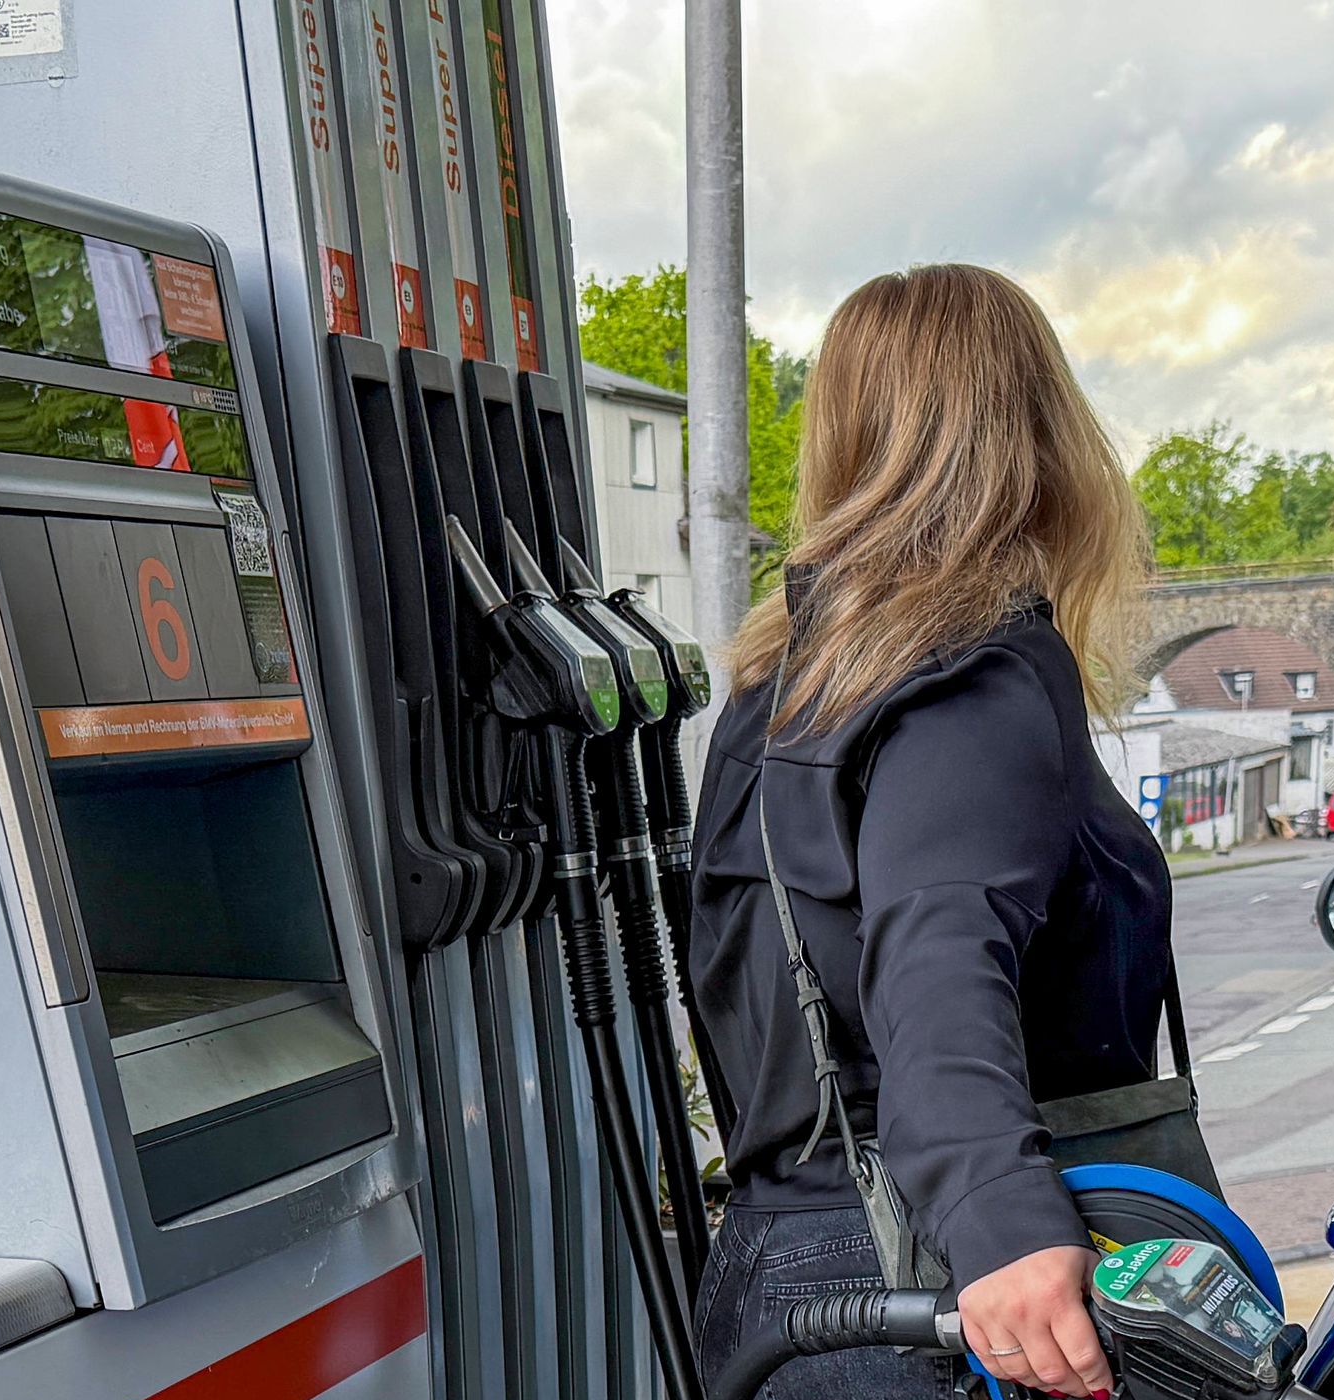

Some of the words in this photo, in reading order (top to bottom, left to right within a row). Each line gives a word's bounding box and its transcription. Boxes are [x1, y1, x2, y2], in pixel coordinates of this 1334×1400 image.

[302, 0, 330, 152] Supe
[372, 10, 400, 175] Super
[435, 38, 462, 194] Super
[486, 29, 520, 218] Diesel
[137, 556, 192, 682] 6
[105, 722, 132, 736] Namen
[133, 720, 149, 735] und
[149, 718, 187, 735] Rechnung
[187, 716, 200, 731] der
[1108, 1271, 1137, 1291] E10
[1126, 1243, 1161, 1272] Super
